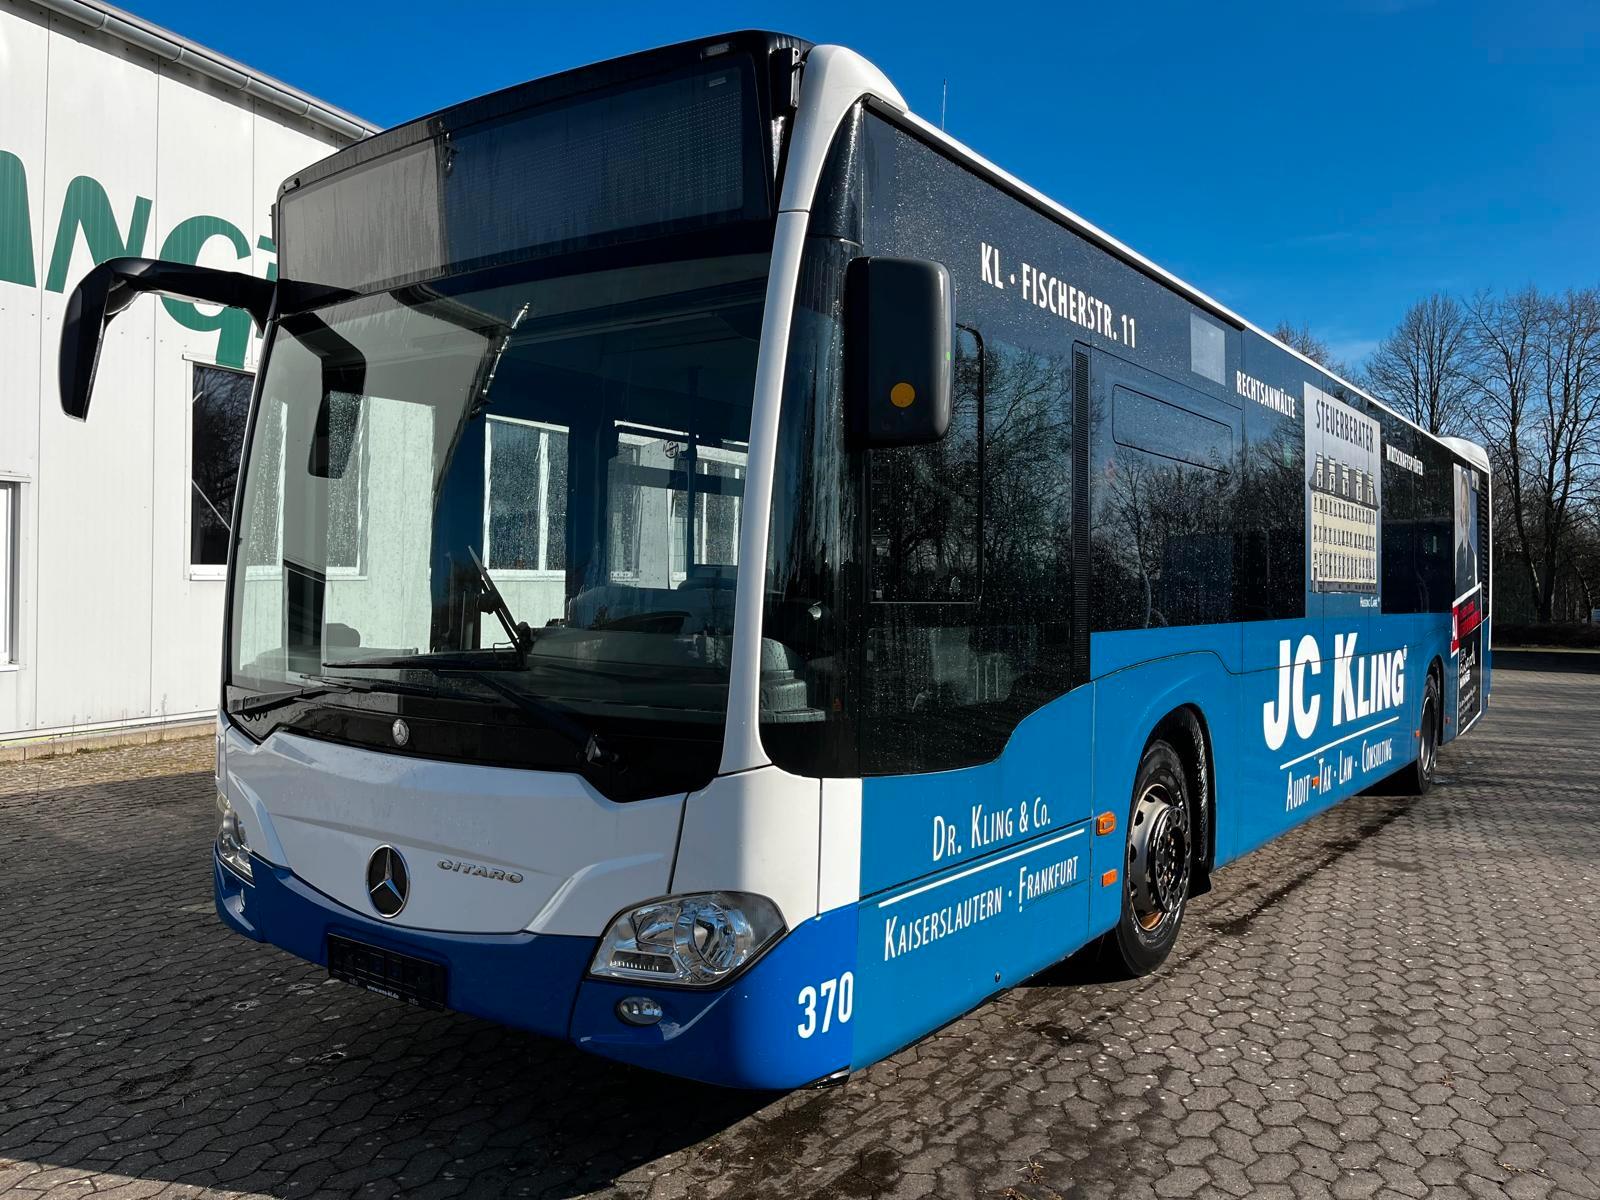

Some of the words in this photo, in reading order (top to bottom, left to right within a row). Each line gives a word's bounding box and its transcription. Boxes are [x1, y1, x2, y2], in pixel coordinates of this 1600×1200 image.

[981, 242, 1004, 289] KL
[1022, 262, 1118, 341] FISCHERSTR.
[1121, 314, 1136, 348] 11
[1236, 370, 1297, 419] RECHTSANWÄLTE
[1315, 399, 1374, 454] STEUERBERATER
[1263, 634, 1322, 751] JC
[437, 859, 524, 884] CITARO
[883, 886, 1003, 962] KAISERSLAUTERN
[797, 970, 855, 1040] 370
